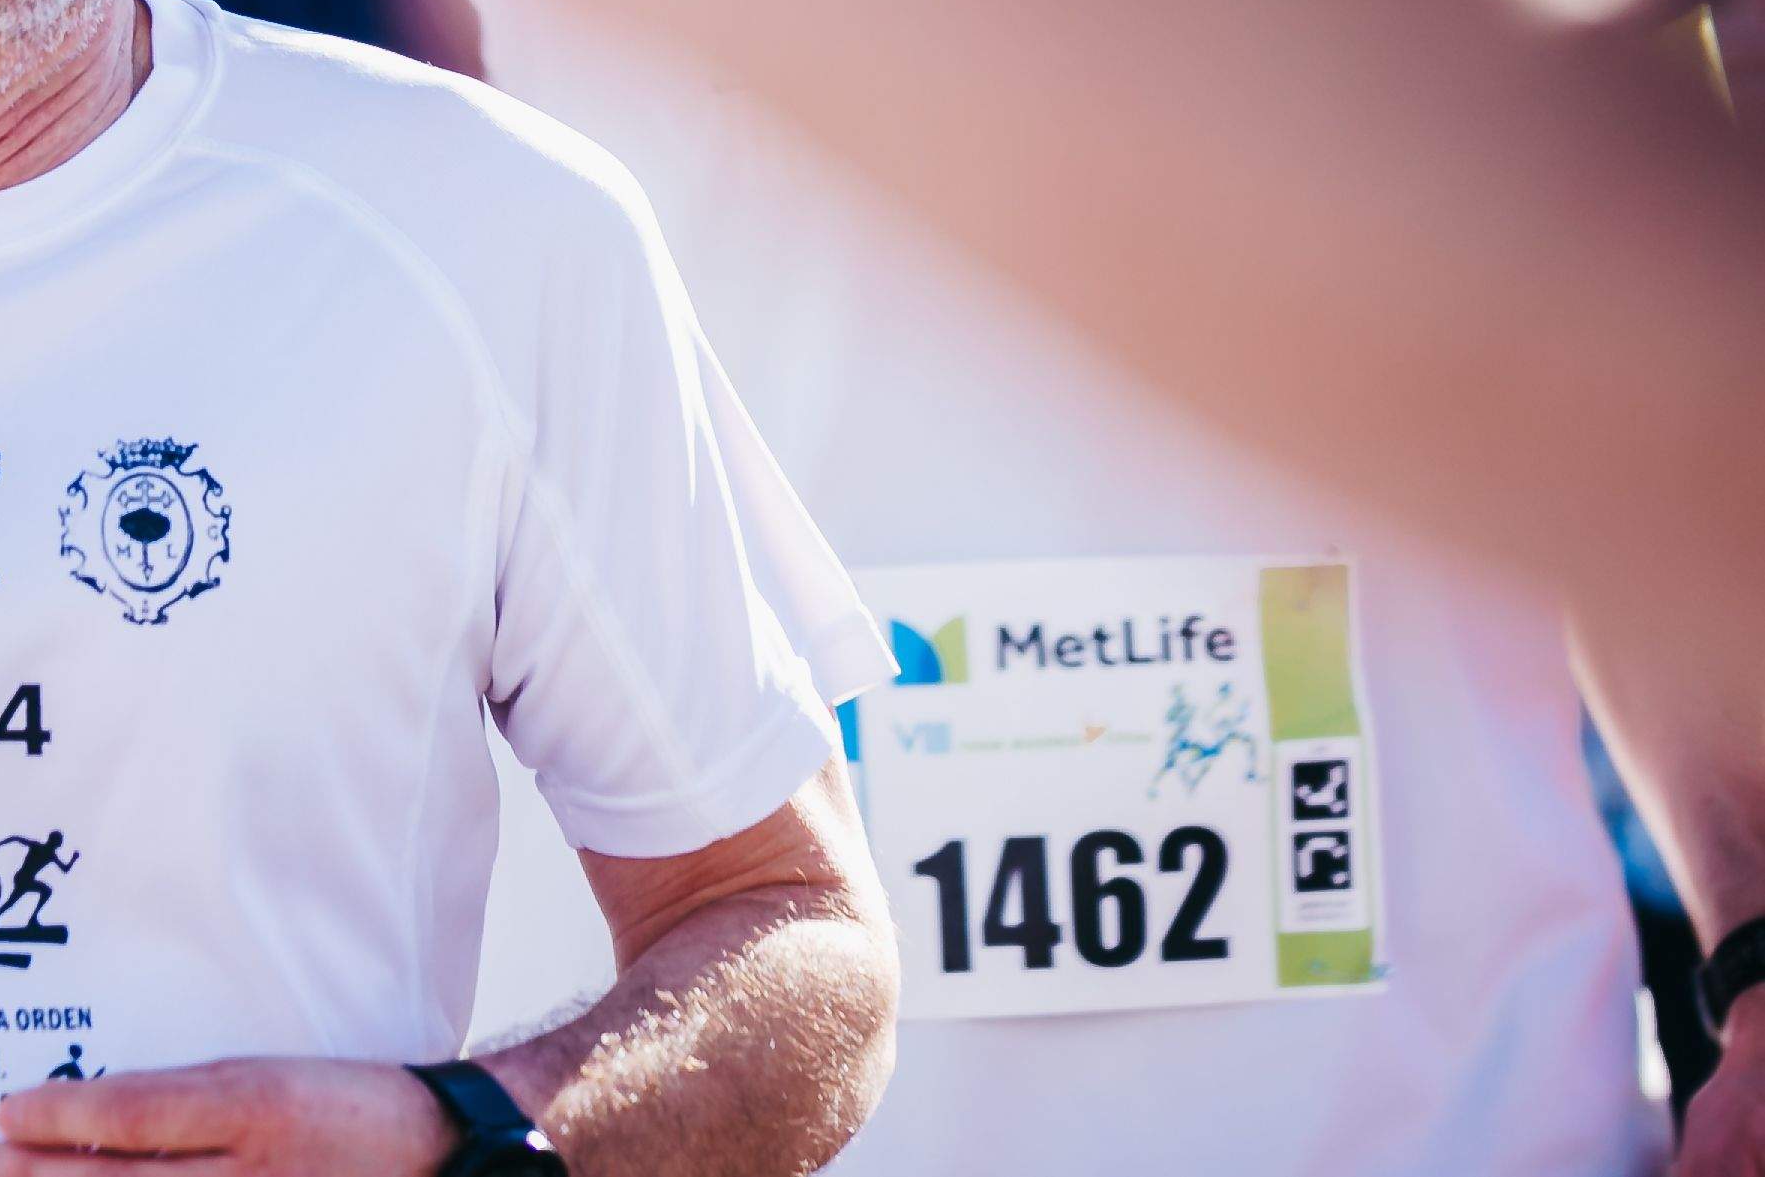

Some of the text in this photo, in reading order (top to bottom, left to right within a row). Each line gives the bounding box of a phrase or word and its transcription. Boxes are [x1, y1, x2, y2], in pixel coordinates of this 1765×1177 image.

[996, 614, 1236, 672] MetLife
[912, 825, 1231, 974] 1462
[15, 1006, 92, 1032] ORDEN
